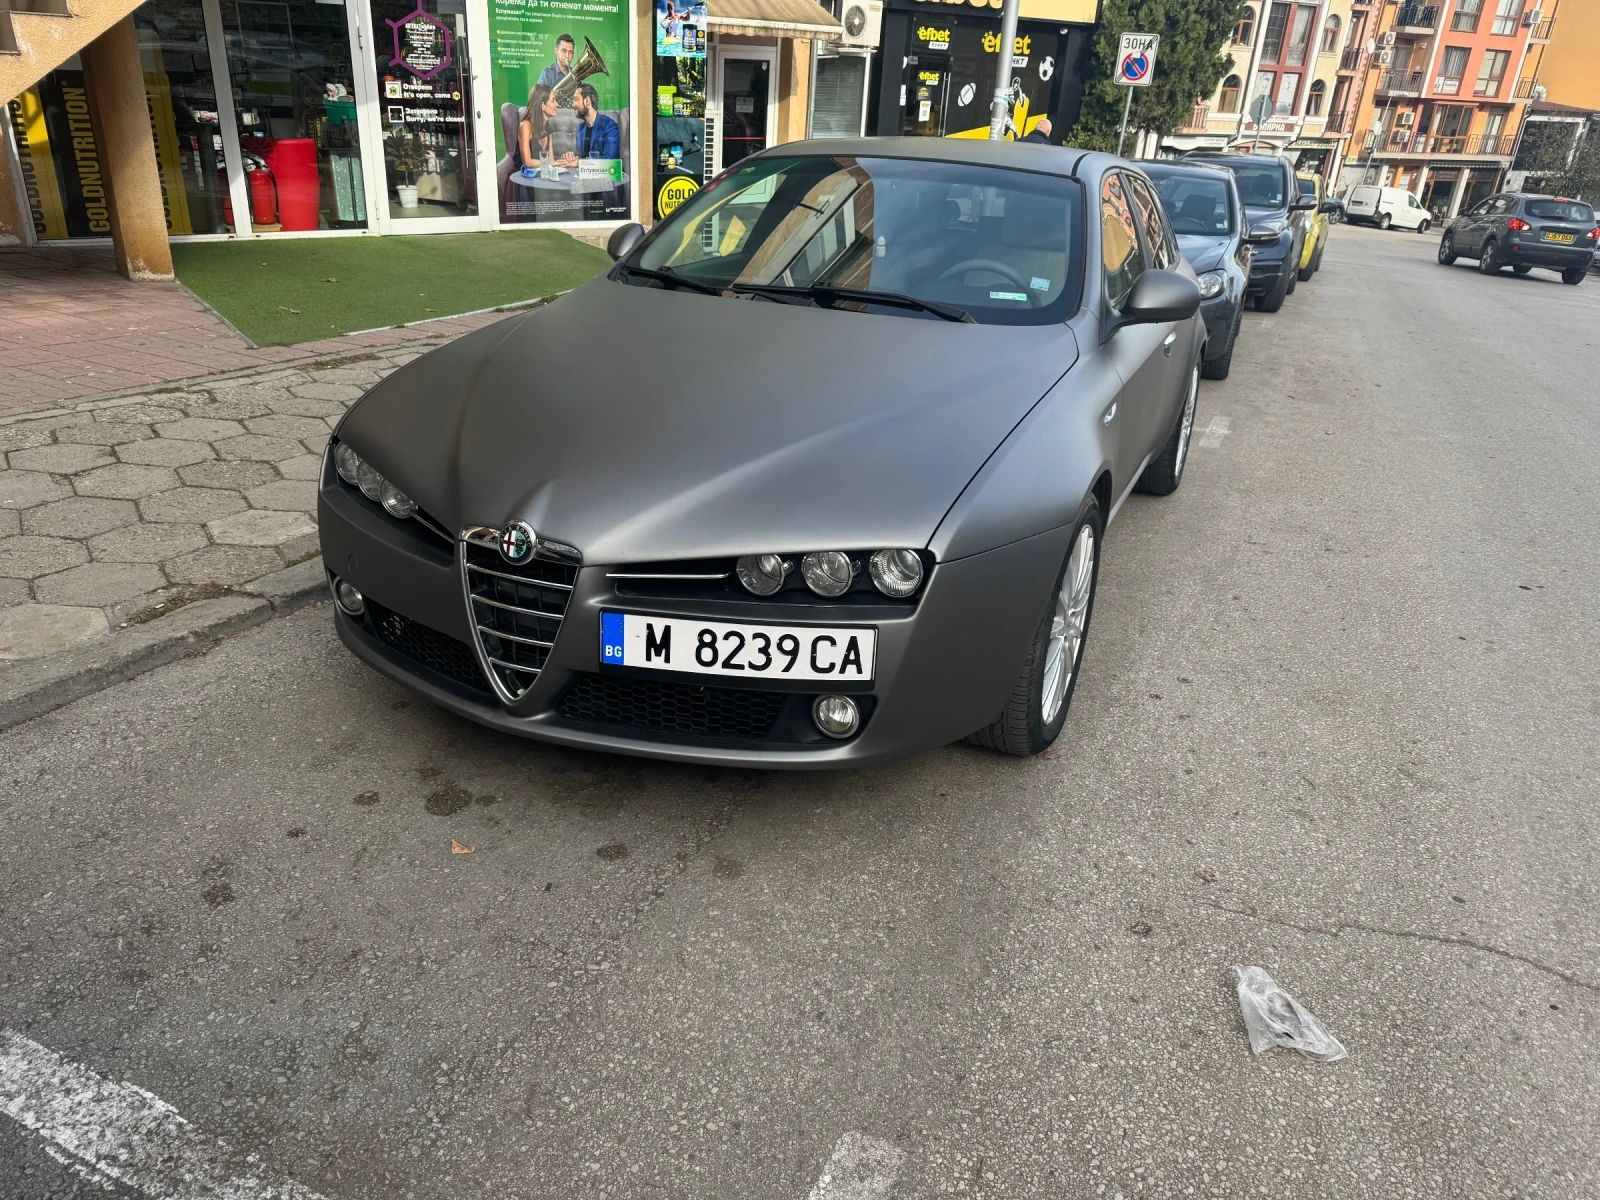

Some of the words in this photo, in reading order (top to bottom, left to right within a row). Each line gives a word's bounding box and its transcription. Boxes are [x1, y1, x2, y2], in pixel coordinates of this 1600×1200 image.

[528, 0, 538, 8] да
[550, 2, 581, 10] отнемат
[583, 4, 619, 13] момента!
[918, 27, 950, 42] efbet
[984, 32, 1031, 54] efet
[1124, 38, 1153, 50] ЗОНА
[919, 72, 940, 80] efbet
[403, 83, 432, 91] Отворено
[605, 645, 622, 657] BG
[645, 623, 671, 664] M
[695, 628, 800, 672] 8239
[810, 635, 863, 674] CA
